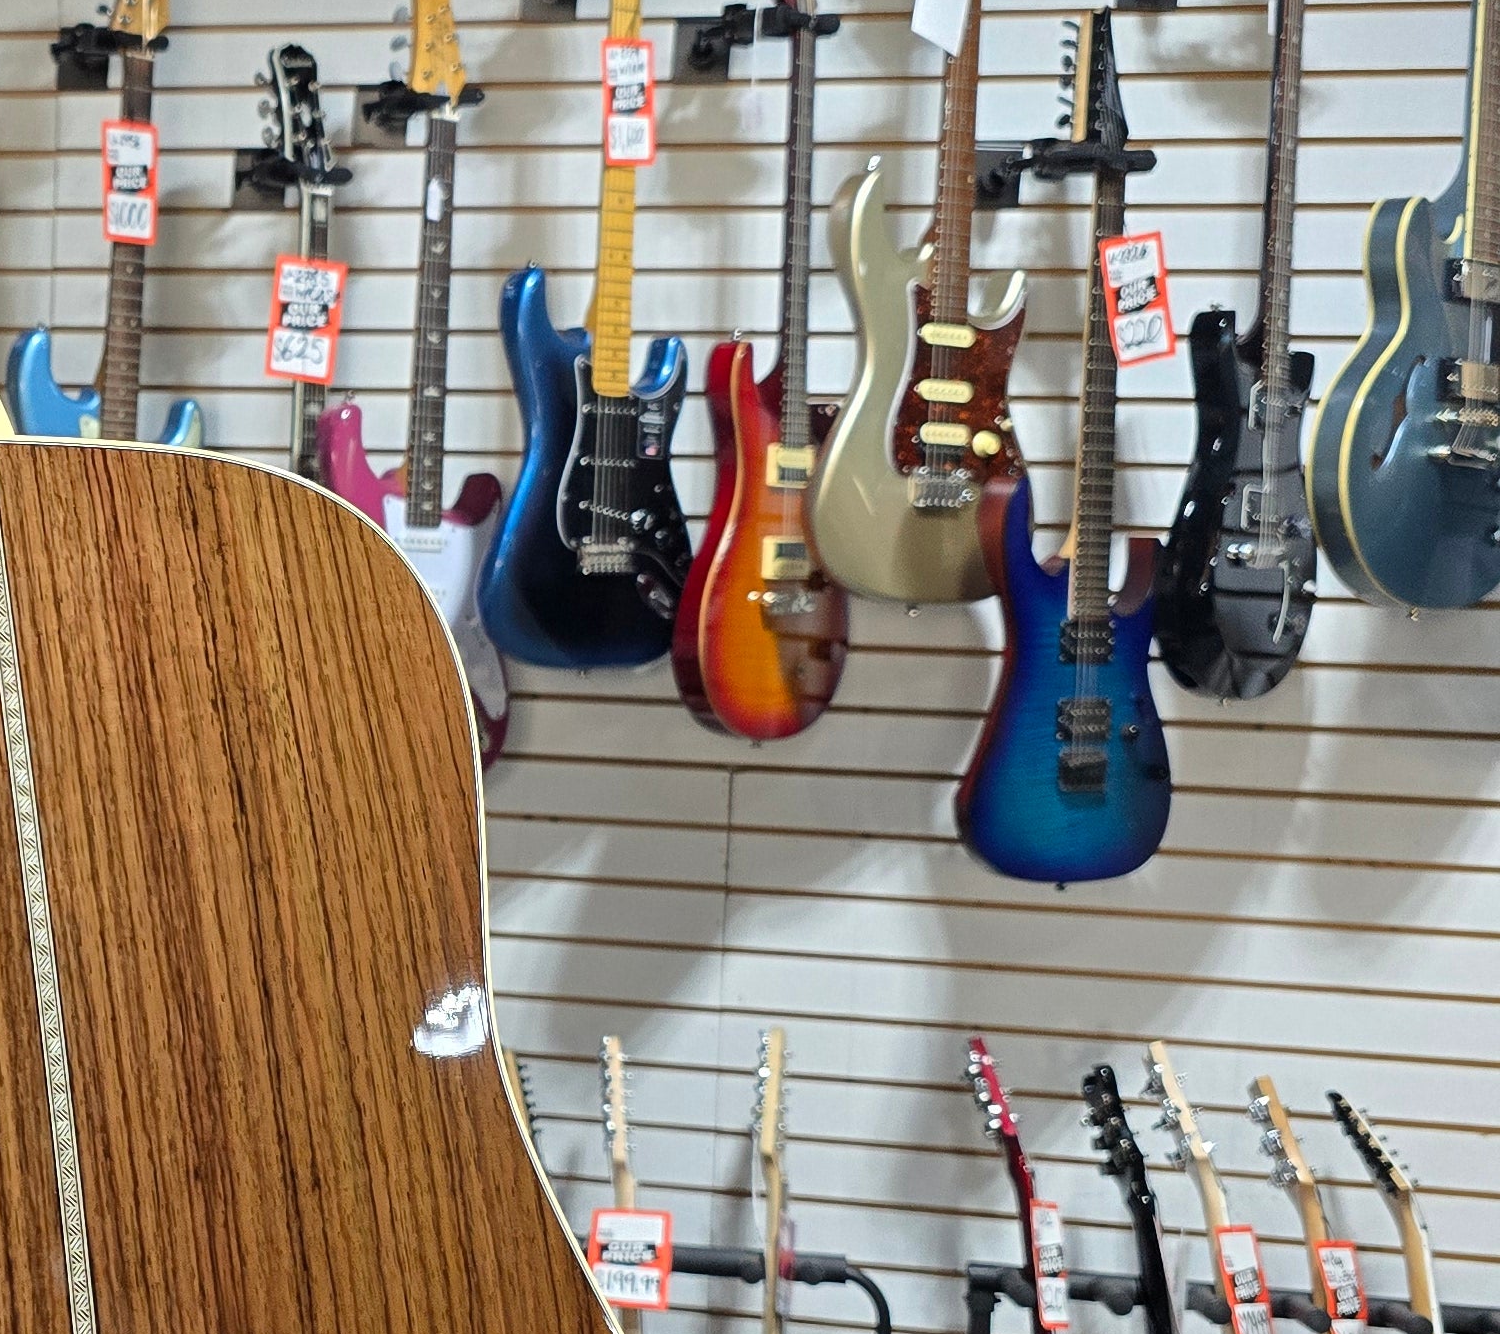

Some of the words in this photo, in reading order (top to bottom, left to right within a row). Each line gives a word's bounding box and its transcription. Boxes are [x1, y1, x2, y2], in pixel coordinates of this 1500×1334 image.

[1120, 278, 1150, 299] OUR
[287, 302, 321, 316] OUR
[1117, 285, 1157, 315] PRICE
[281, 312, 329, 328] PRICE
